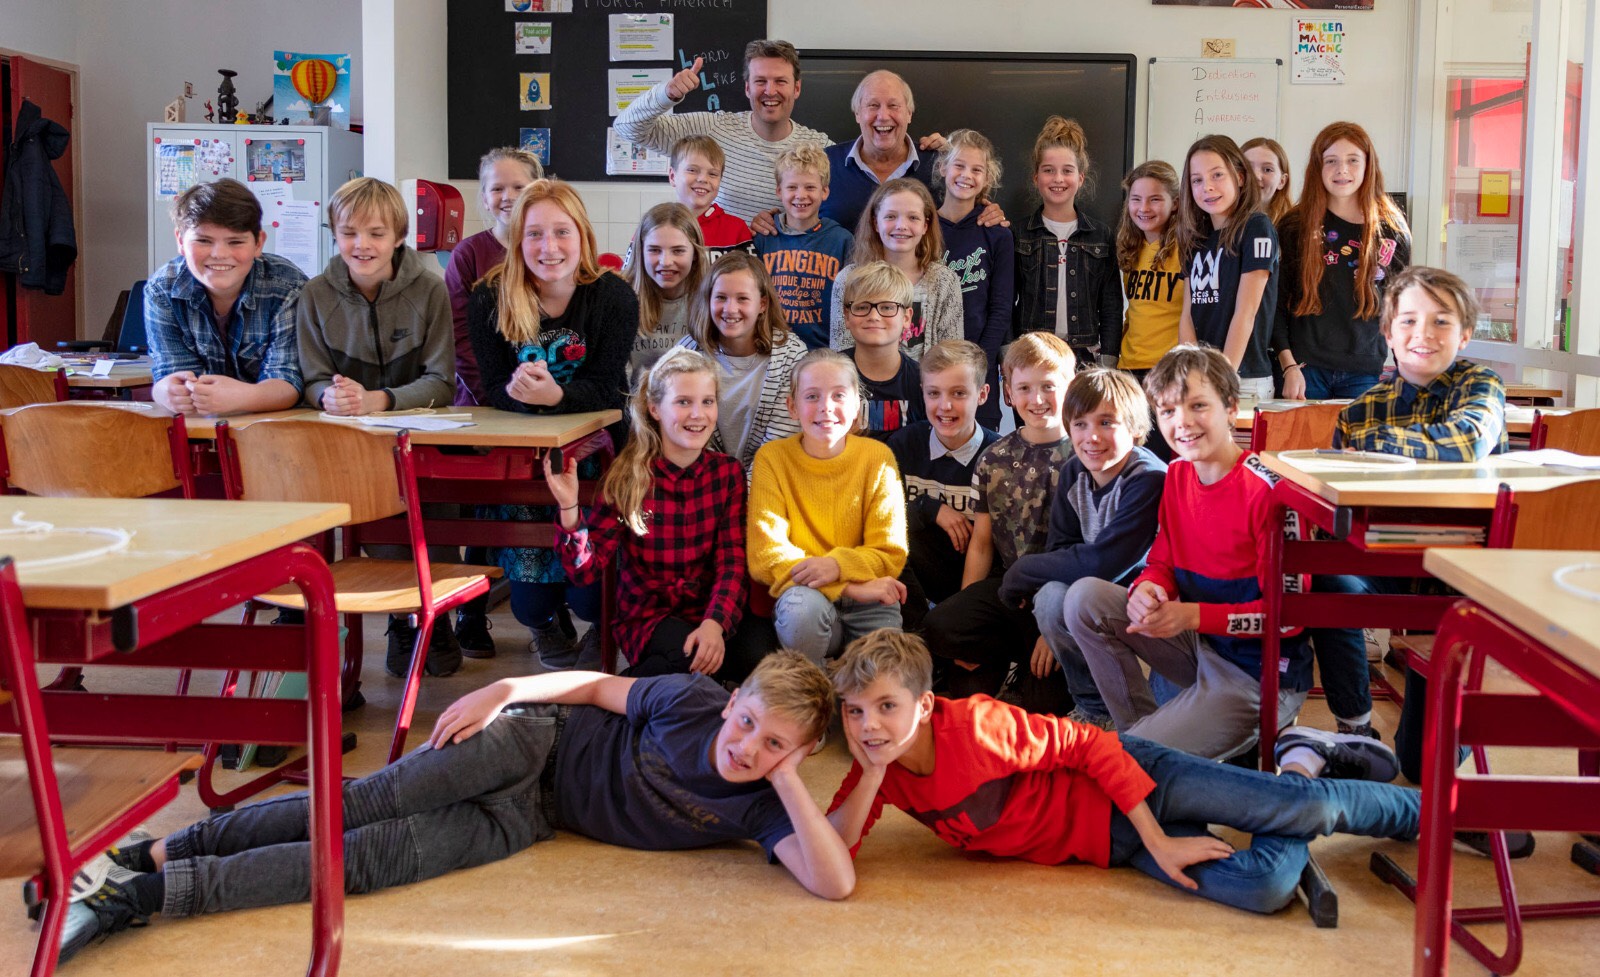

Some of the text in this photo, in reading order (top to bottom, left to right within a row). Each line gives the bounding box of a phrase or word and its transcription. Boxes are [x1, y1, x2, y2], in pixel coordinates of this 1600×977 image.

[763, 249, 840, 281] VINGINO
[801, 277, 826, 290] DENIM
[1127, 269, 1179, 302] BERTY
[783, 308, 823, 324] MPANY
[656, 322, 677, 335] ANT
[859, 399, 909, 431] OMMY
